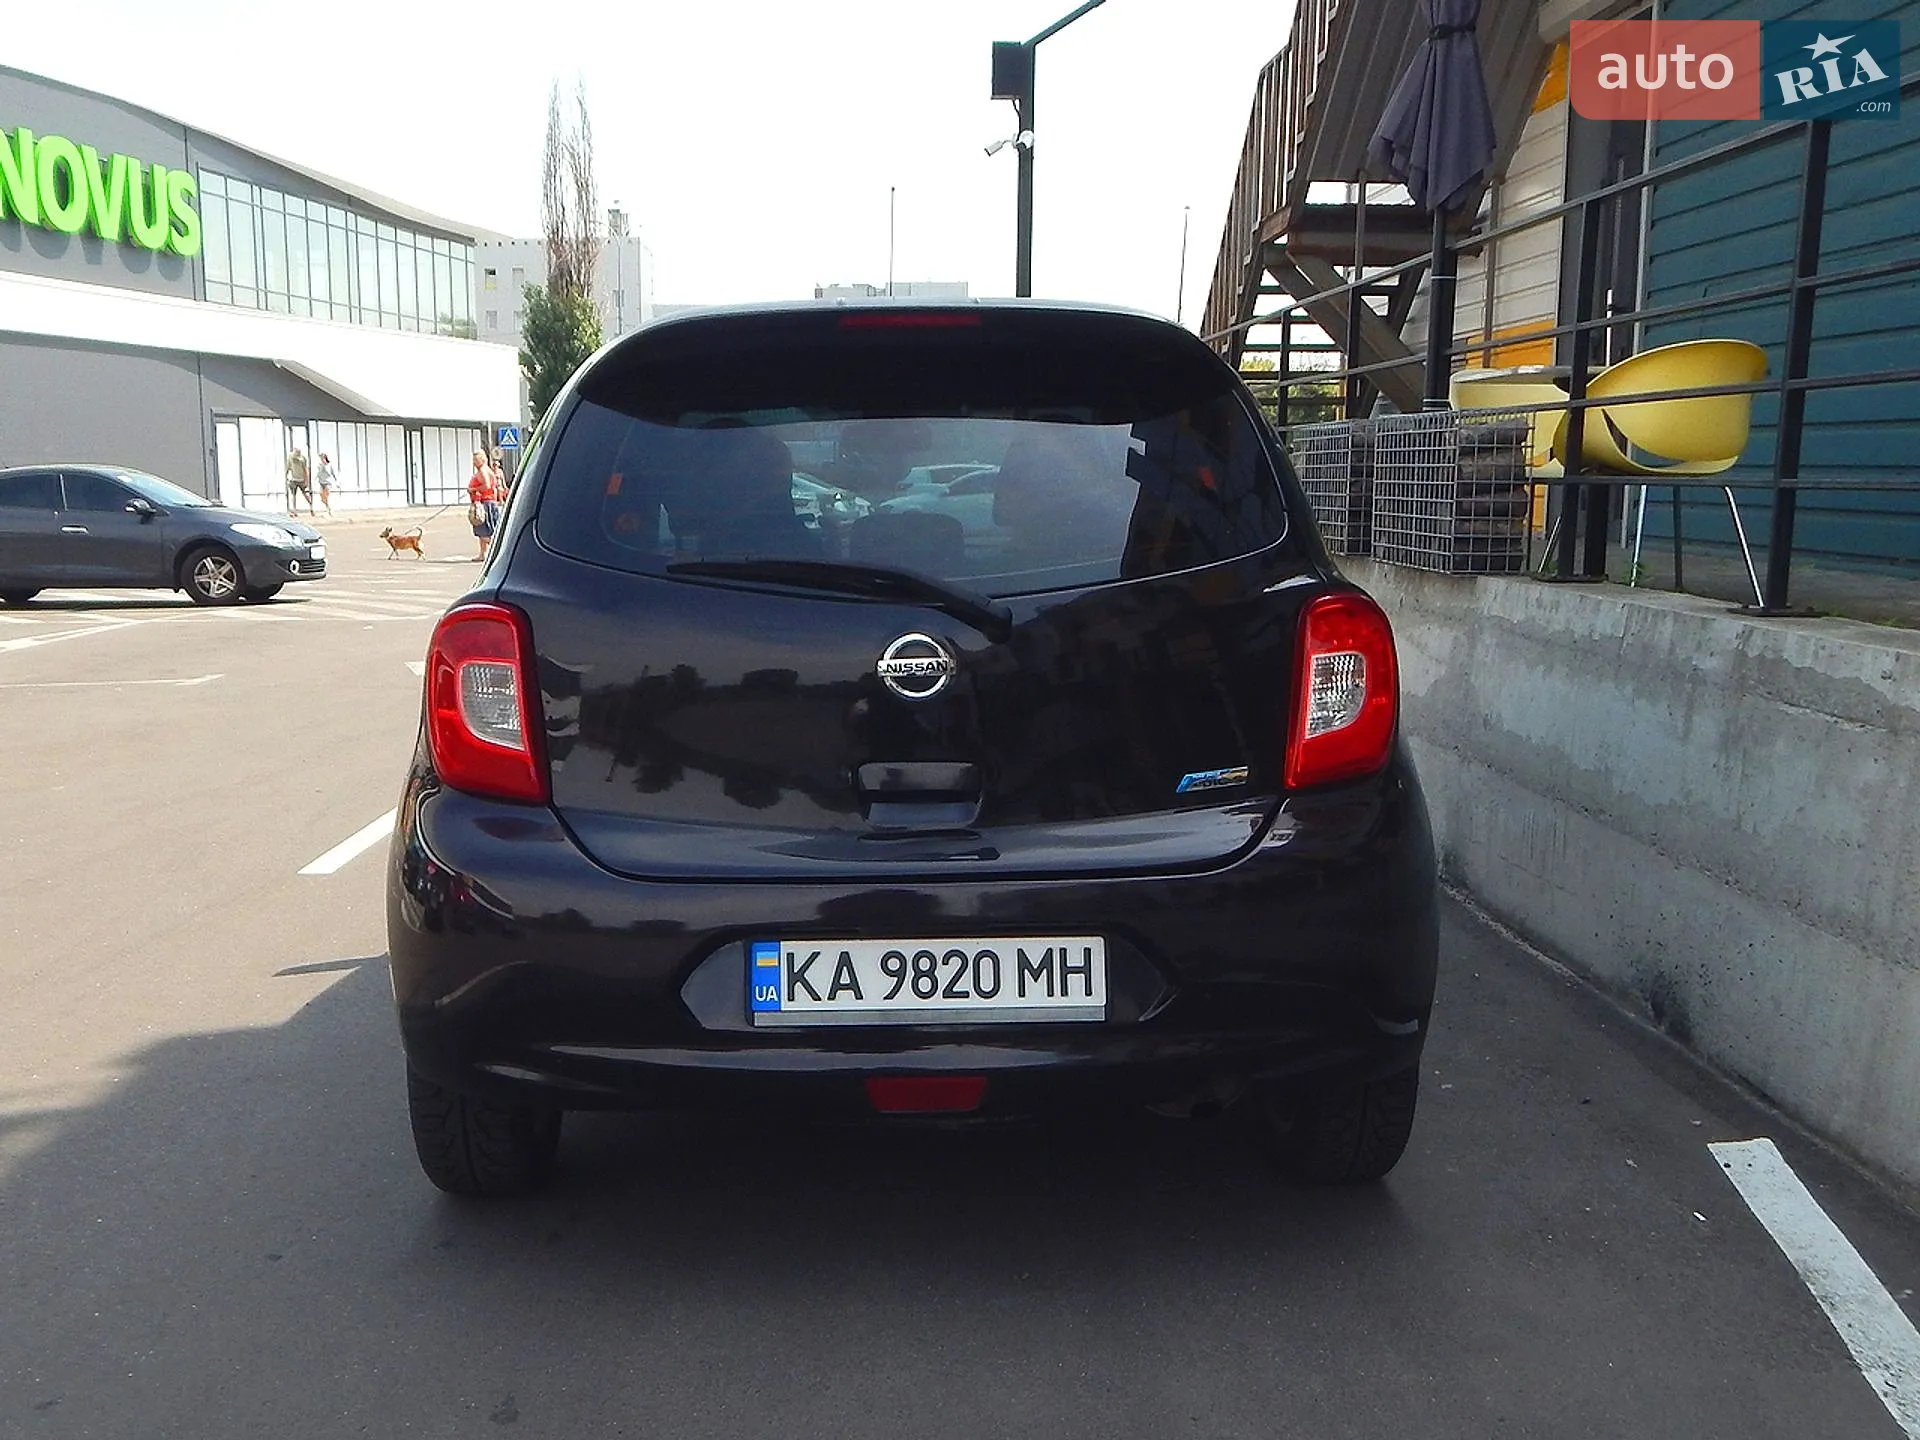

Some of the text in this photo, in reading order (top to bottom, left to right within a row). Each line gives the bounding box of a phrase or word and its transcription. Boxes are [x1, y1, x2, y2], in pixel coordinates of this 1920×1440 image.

[0, 127, 201, 256] NOVUS
[886, 660, 948, 673] NISSAN
[785, 946, 1094, 1002] KA 9820 MH
[755, 985, 779, 1002] UA
